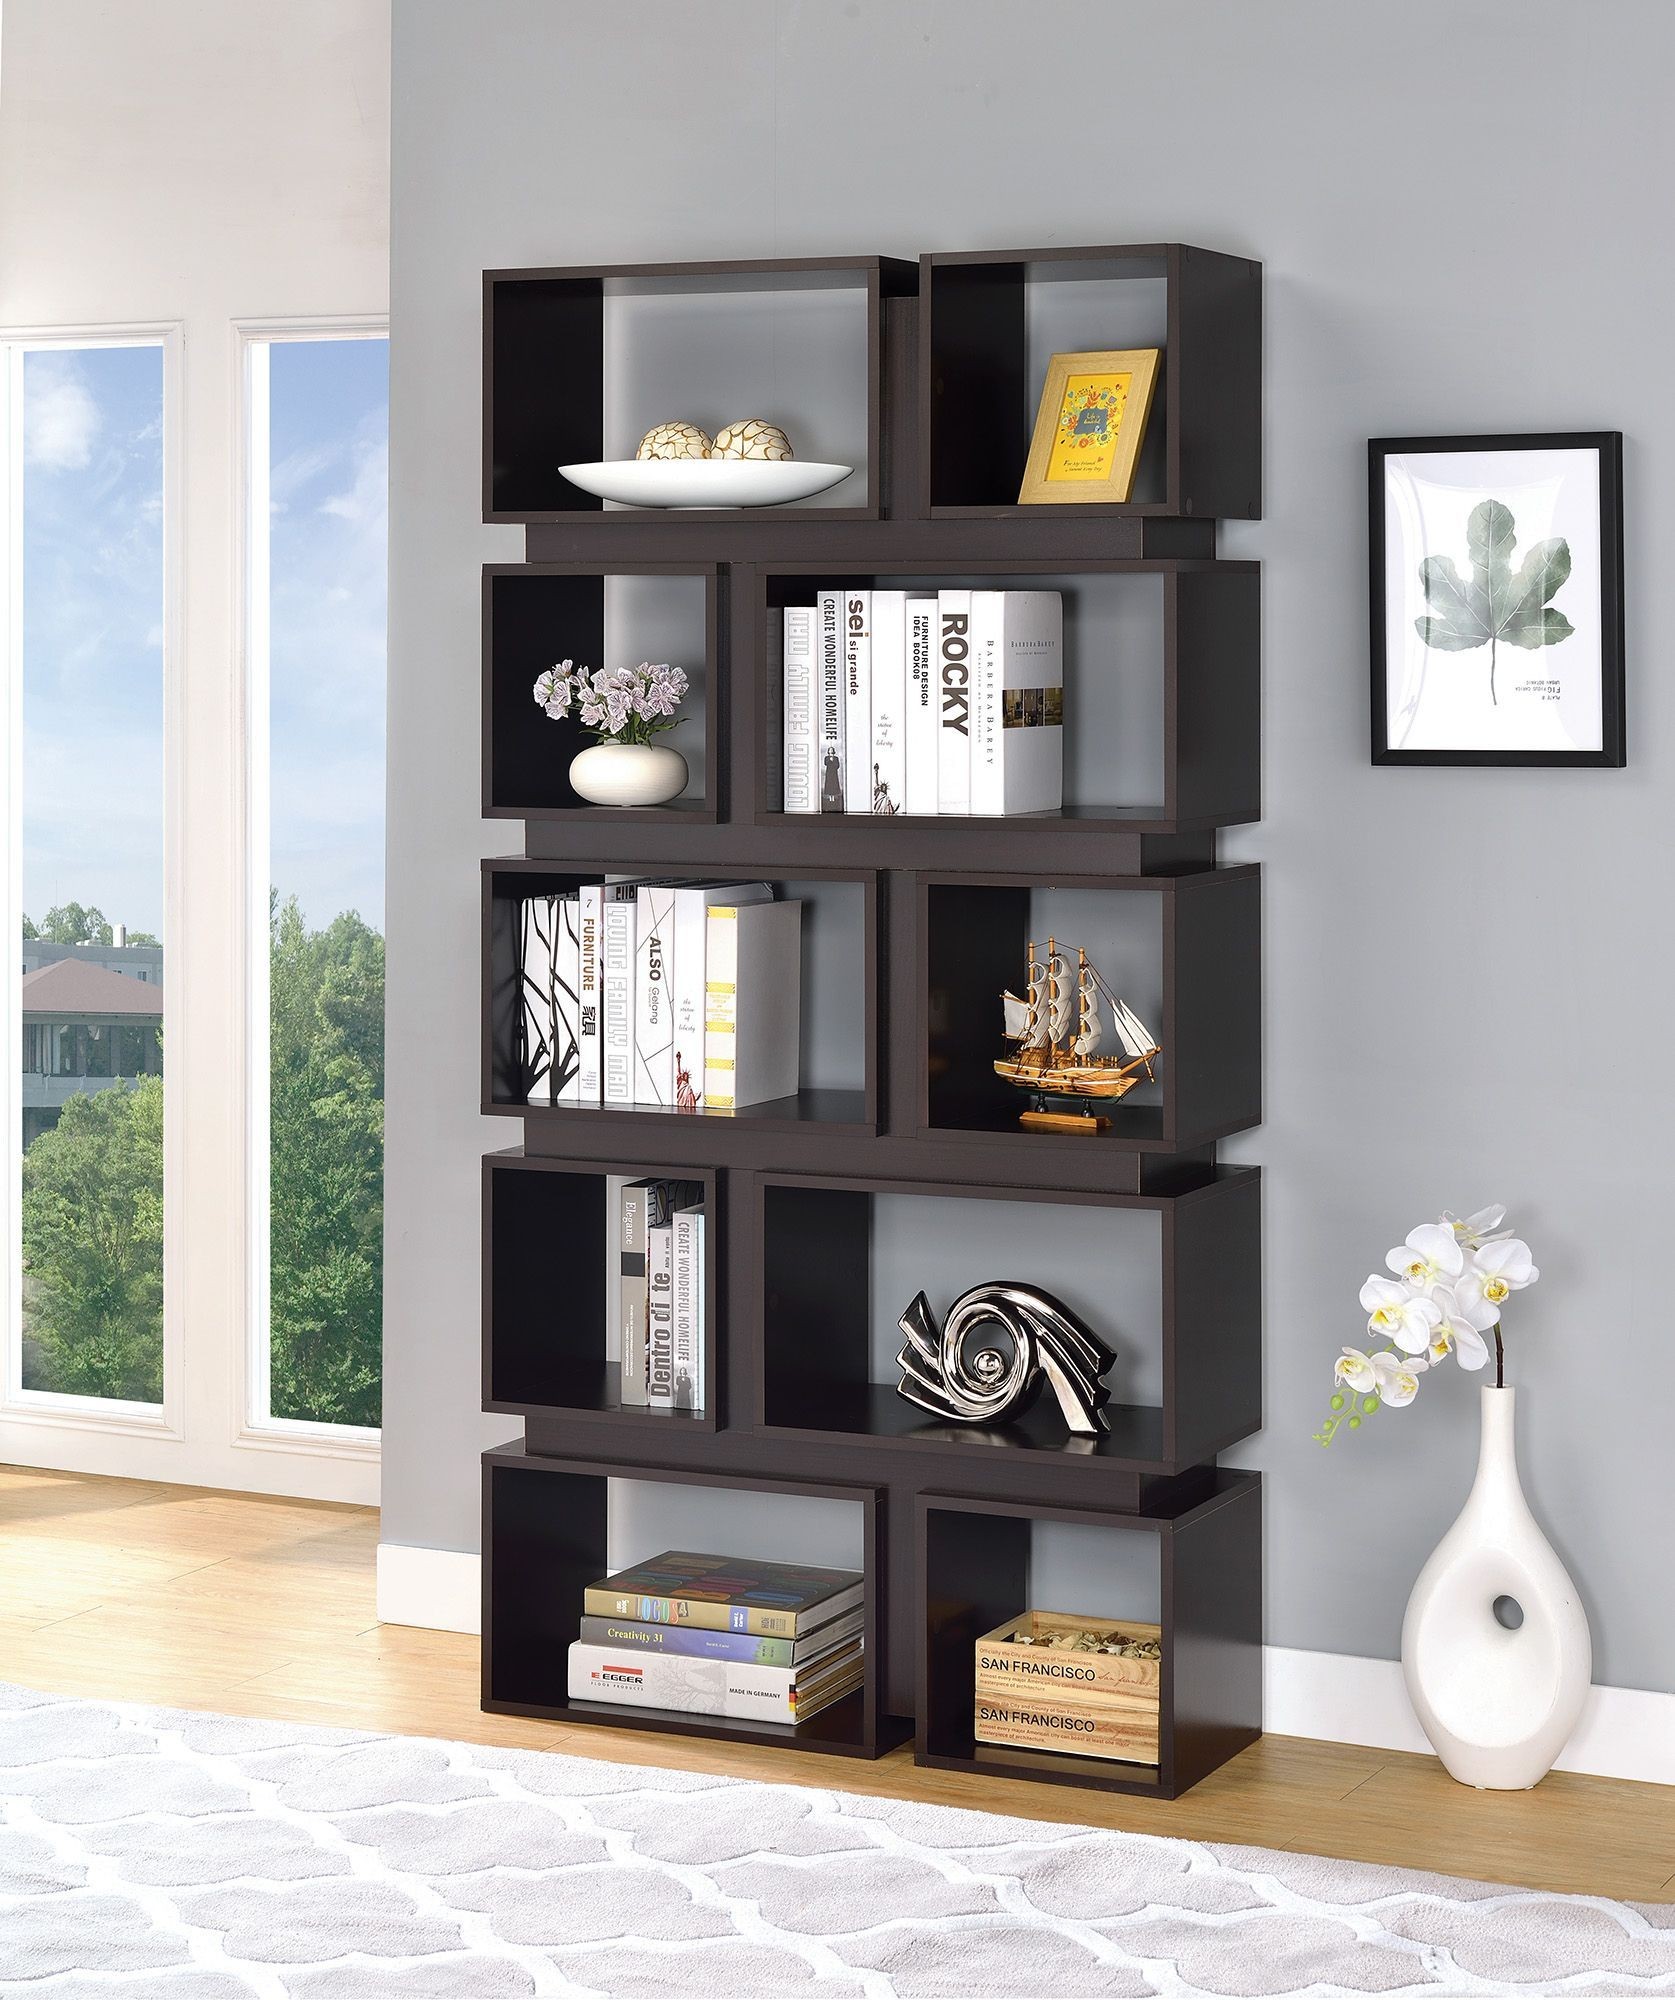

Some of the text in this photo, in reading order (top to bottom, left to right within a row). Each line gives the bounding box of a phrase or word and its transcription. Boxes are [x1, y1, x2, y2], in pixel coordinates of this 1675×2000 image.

[787, 613, 809, 655] MAN
[848, 599, 869, 695] sei si grande
[823, 598, 837, 740] CREATE WONDERFUL HOMELIFE
[912, 642, 920, 680] BOOK08
[921, 615, 929, 706] FURNITURE DESIGN
[942, 613, 969, 736] ROCKY
[787, 664, 809, 734] FAMILY
[1547, 686, 1561, 694] FIG
[583, 918, 595, 991] FURNITURE
[649, 936, 662, 982] ALSO
[607, 976, 628, 1047] FAMILY
[607, 1054, 629, 1098] MAN
[622, 1201, 637, 1245] Elegance
[678, 1222, 690, 1361] CREATE WONDERFUL HOMELIFE
[650, 1272, 671, 1397] Dentro di te
[607, 1628, 664, 1643] Creativity 31
[602, 1673, 643, 1684] EGGER
[981, 1657, 1096, 1682] SAN FRANCISCO
[729, 1687, 745, 1695] MADE
[753, 1690, 781, 1699] GERMANY
[980, 1707, 1095, 1733] SAN FRANCISCO
